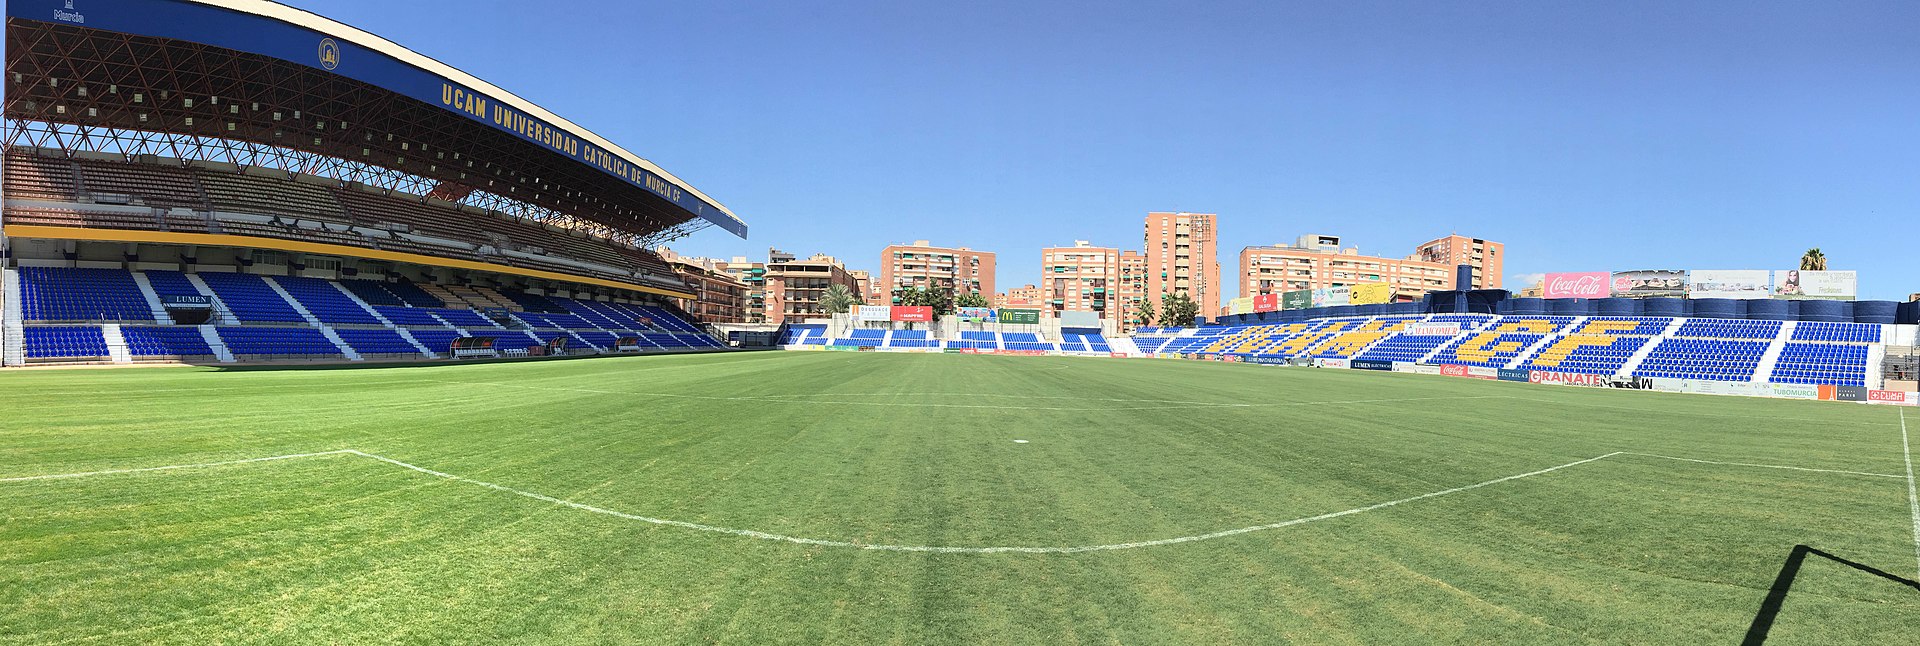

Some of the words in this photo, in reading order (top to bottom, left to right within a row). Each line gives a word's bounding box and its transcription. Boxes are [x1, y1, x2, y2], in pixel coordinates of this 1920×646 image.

[53, 9, 85, 24] Murcia
[442, 83, 486, 119] UCAM
[494, 104, 577, 156] UNIVERSIDAD
[583, 145, 628, 180] CATÓLICA
[631, 167, 642, 184] DE
[645, 173, 671, 201] MURCIA
[672, 189, 681, 203] CF
[1549, 276, 1604, 295] Coca-Cola
[1531, 370, 1600, 385] GRANATE
[1773, 388, 1817, 397] TUBOMURCIA
